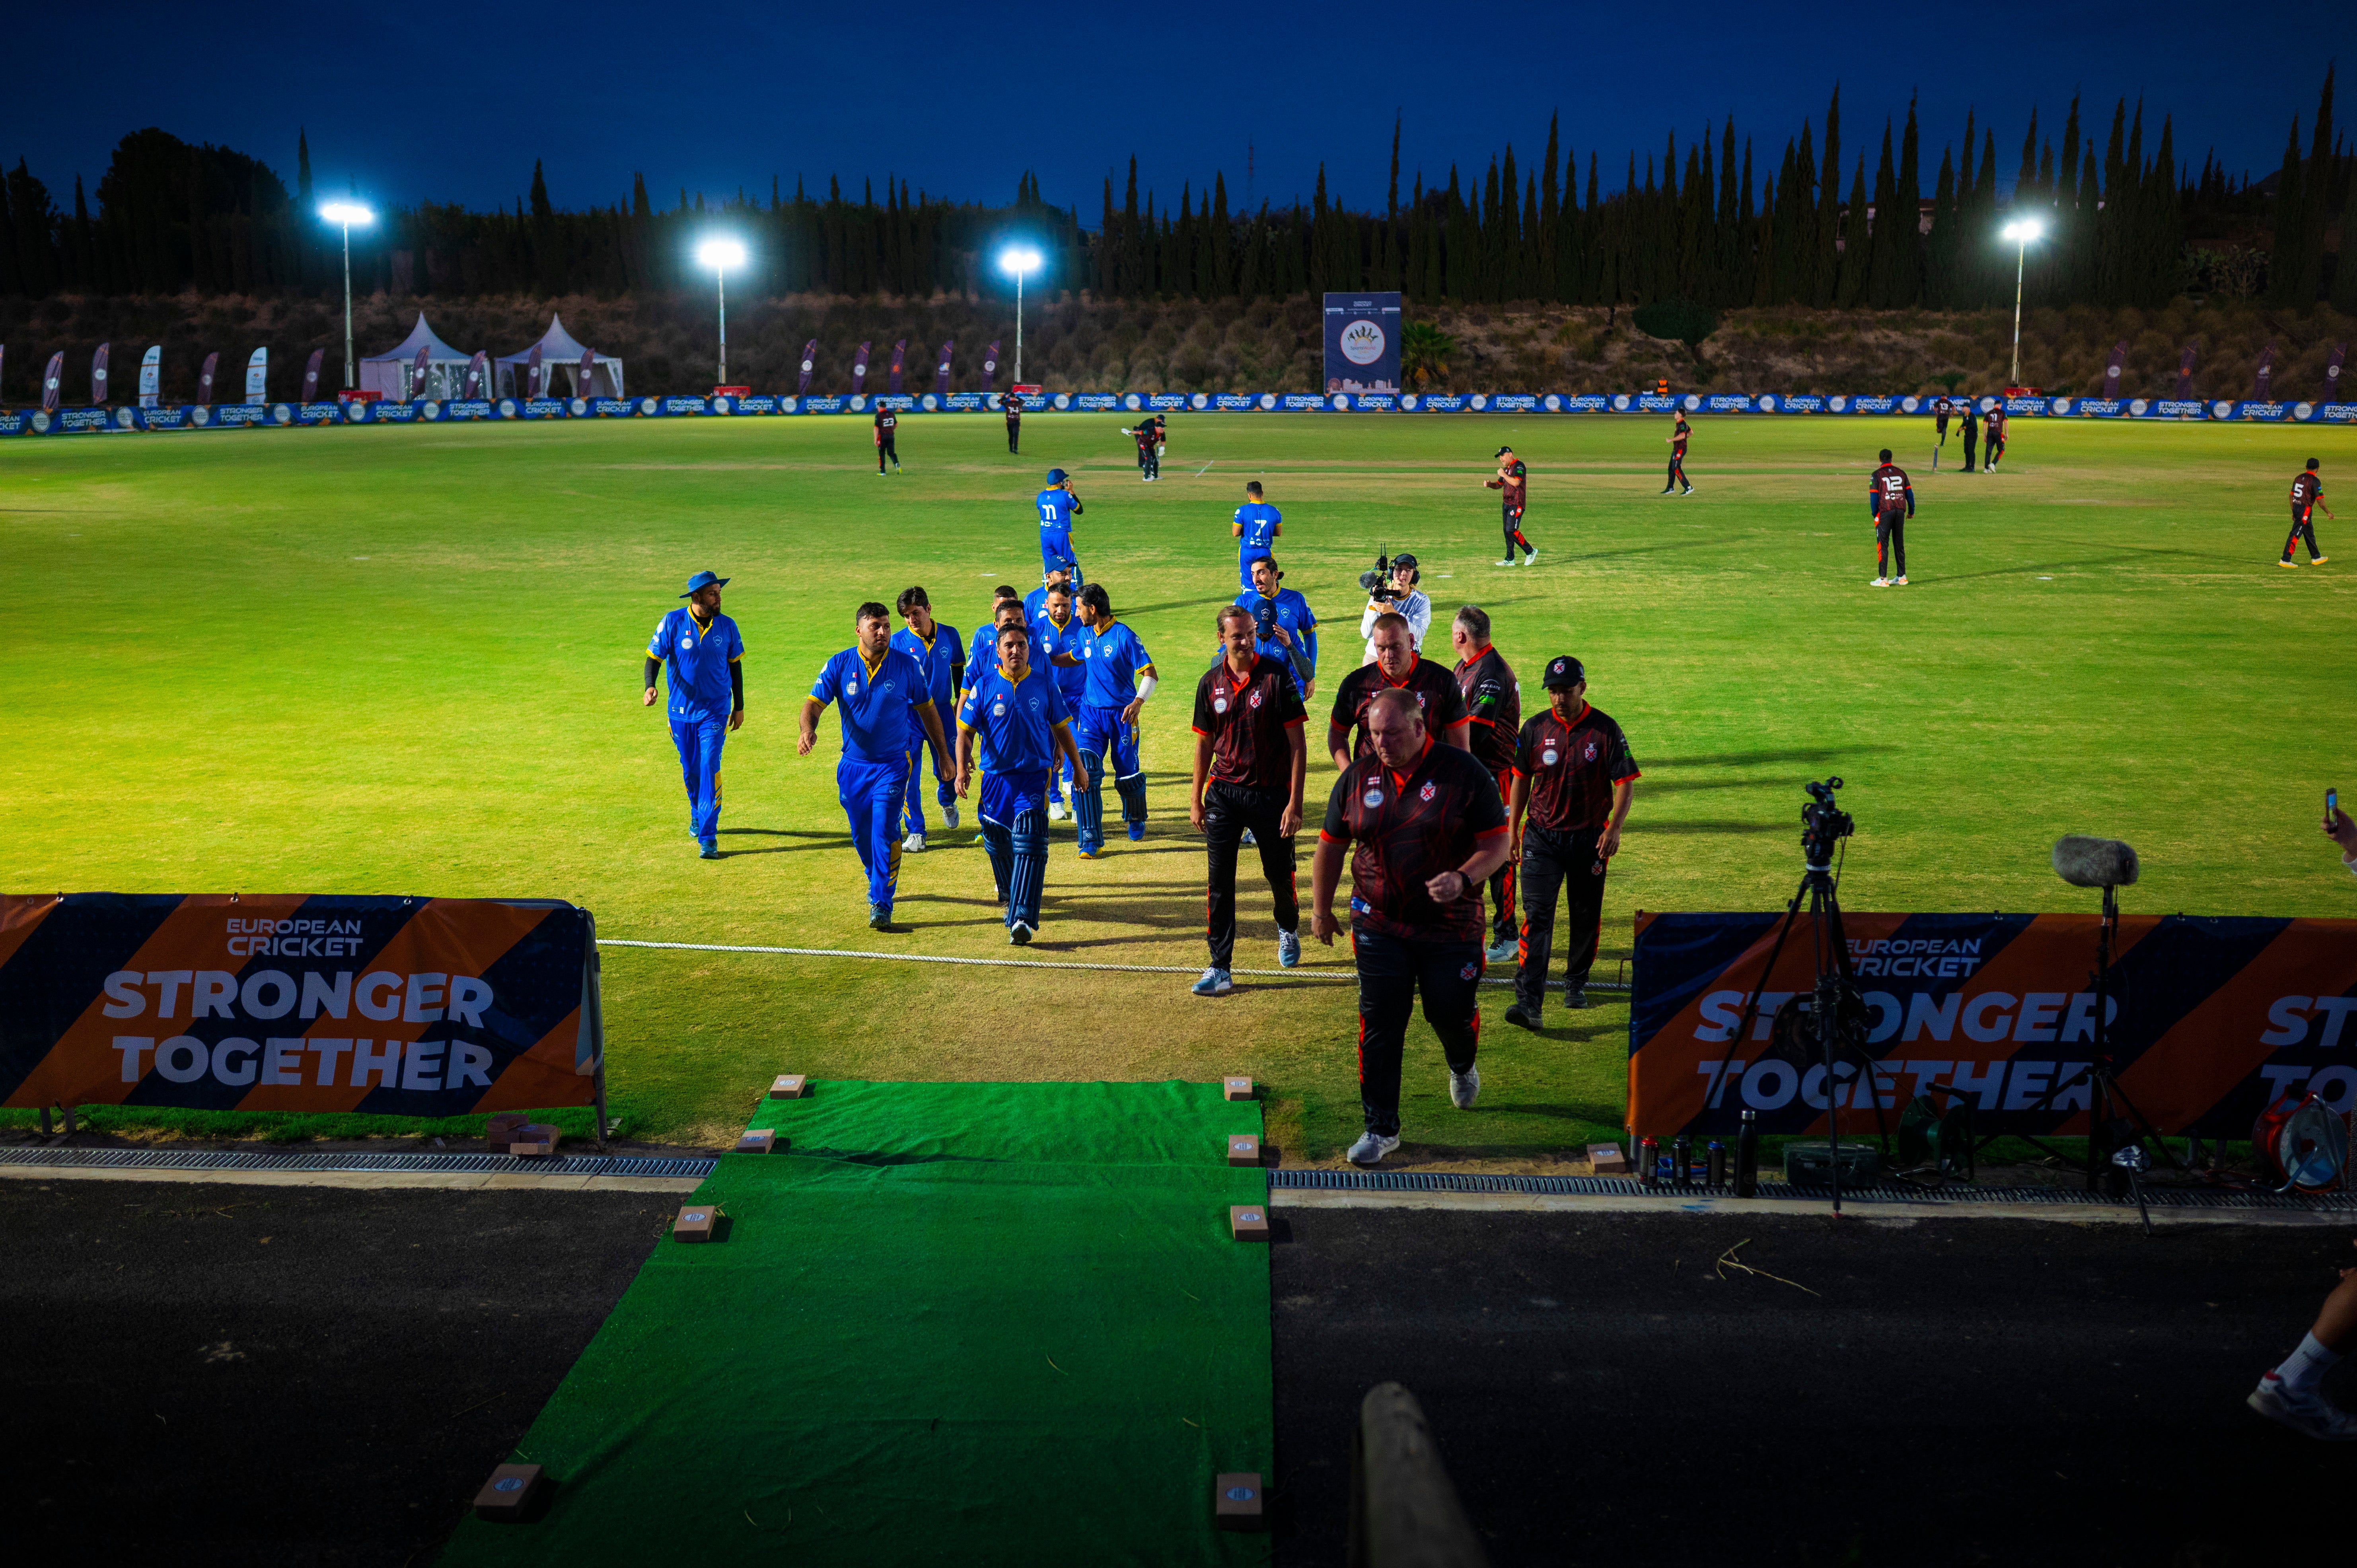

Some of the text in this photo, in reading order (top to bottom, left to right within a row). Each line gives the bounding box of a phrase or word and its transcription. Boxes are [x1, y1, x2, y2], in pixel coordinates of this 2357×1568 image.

[62, 411, 105, 420] STRONGER
[62, 418, 106, 427] TOGETHER
[883, 418, 894, 426] 23
[1882, 476, 1903, 491] 12
[2294, 483, 2304, 497] 5
[1042, 504, 1057, 519] 11
[1254, 519, 1267, 536] 7
[227, 918, 361, 935] EUROPEAN
[227, 937, 363, 956] CRICKET
[102, 969, 494, 1028] STRONGER
[1693, 990, 2118, 1043] STONGER
[112, 1035, 493, 1091] TOGETHER
